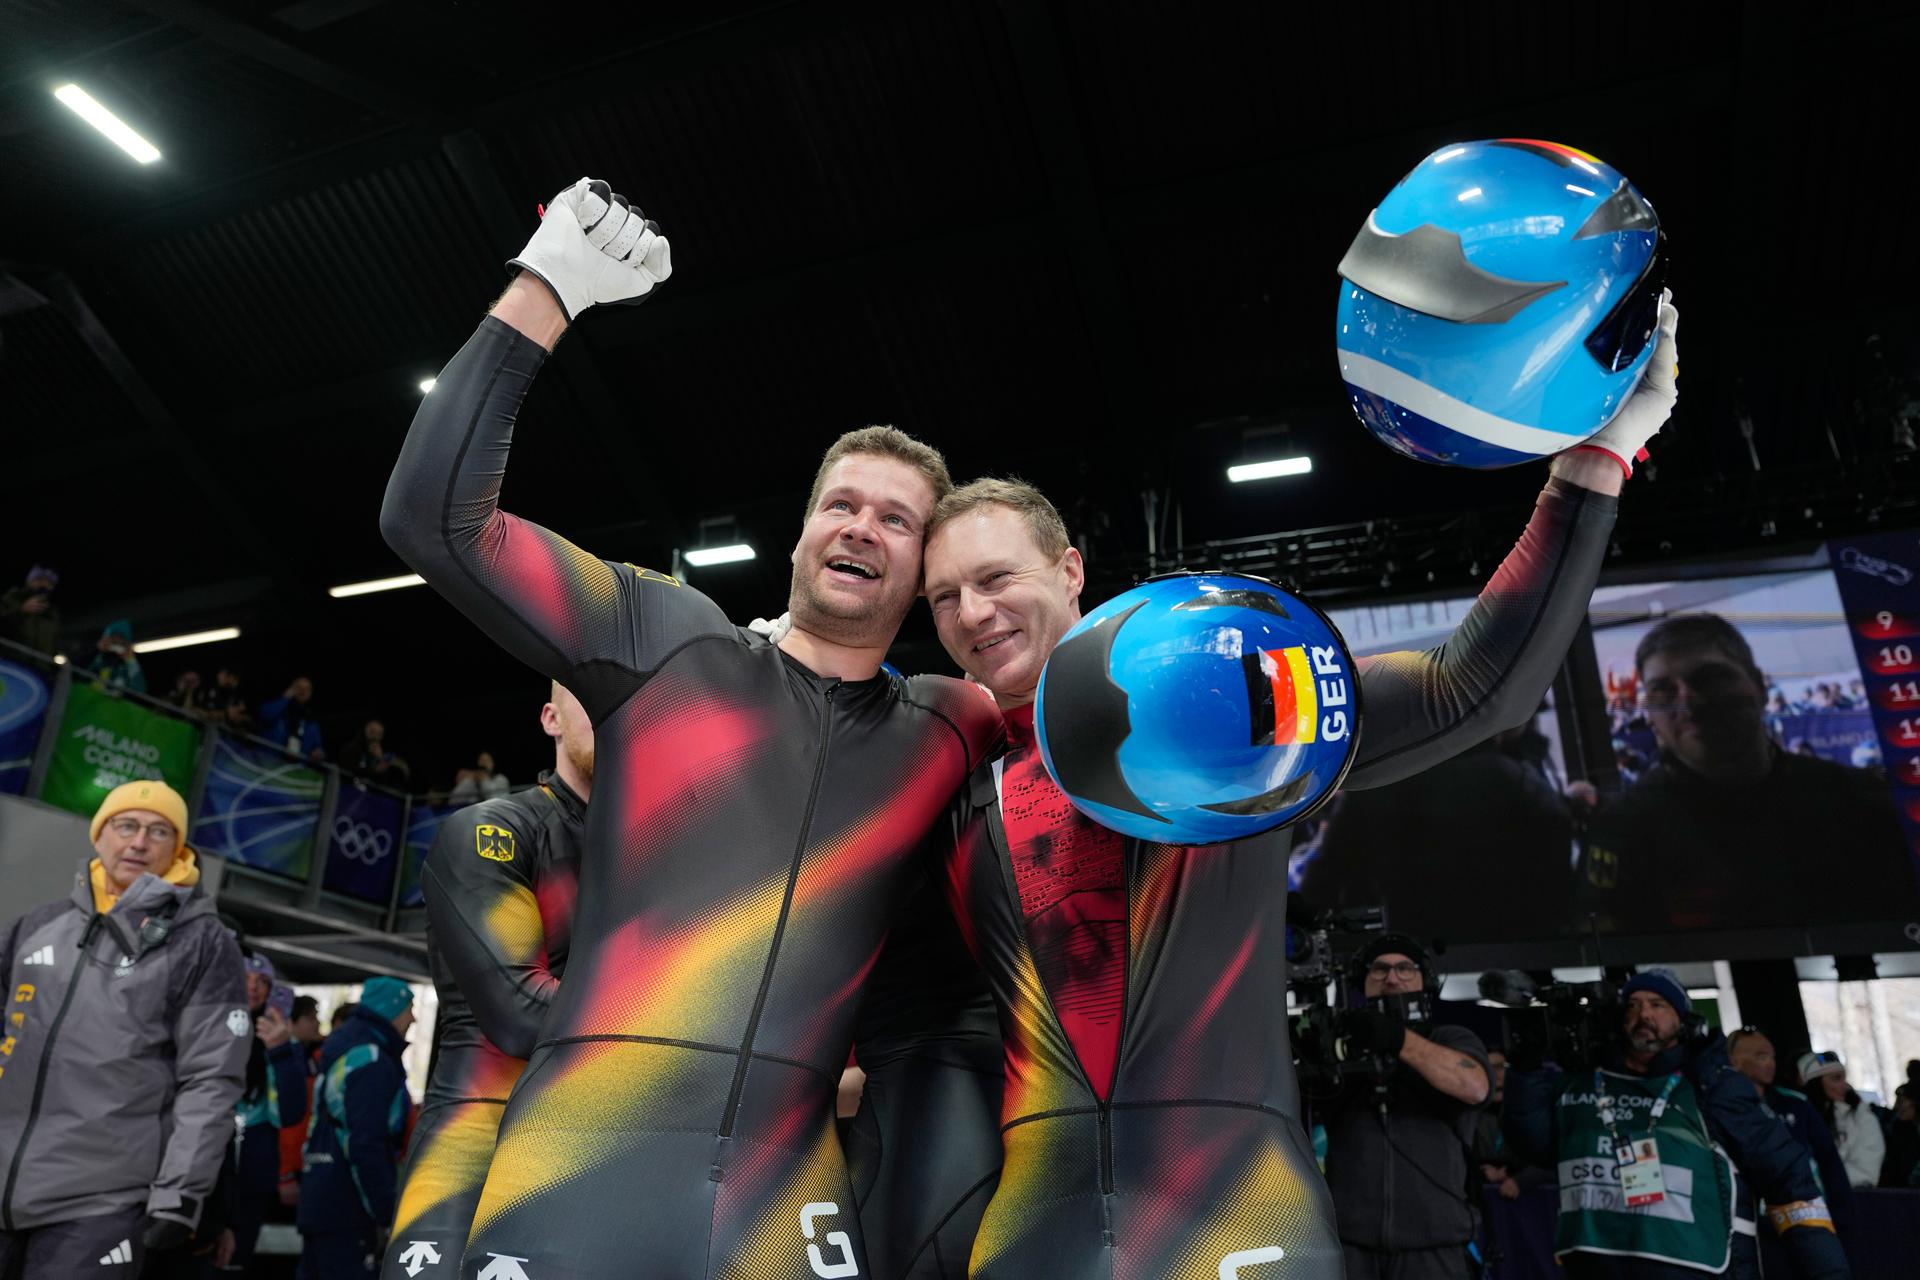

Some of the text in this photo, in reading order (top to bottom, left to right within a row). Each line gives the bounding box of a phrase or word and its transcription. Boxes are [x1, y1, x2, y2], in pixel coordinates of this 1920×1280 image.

[1876, 611, 1894, 631] 9
[1880, 644, 1913, 667] 10
[1311, 645, 1347, 742] GER
[73, 725, 160, 764] MILANO
[1572, 1164, 1604, 1180] CSC
